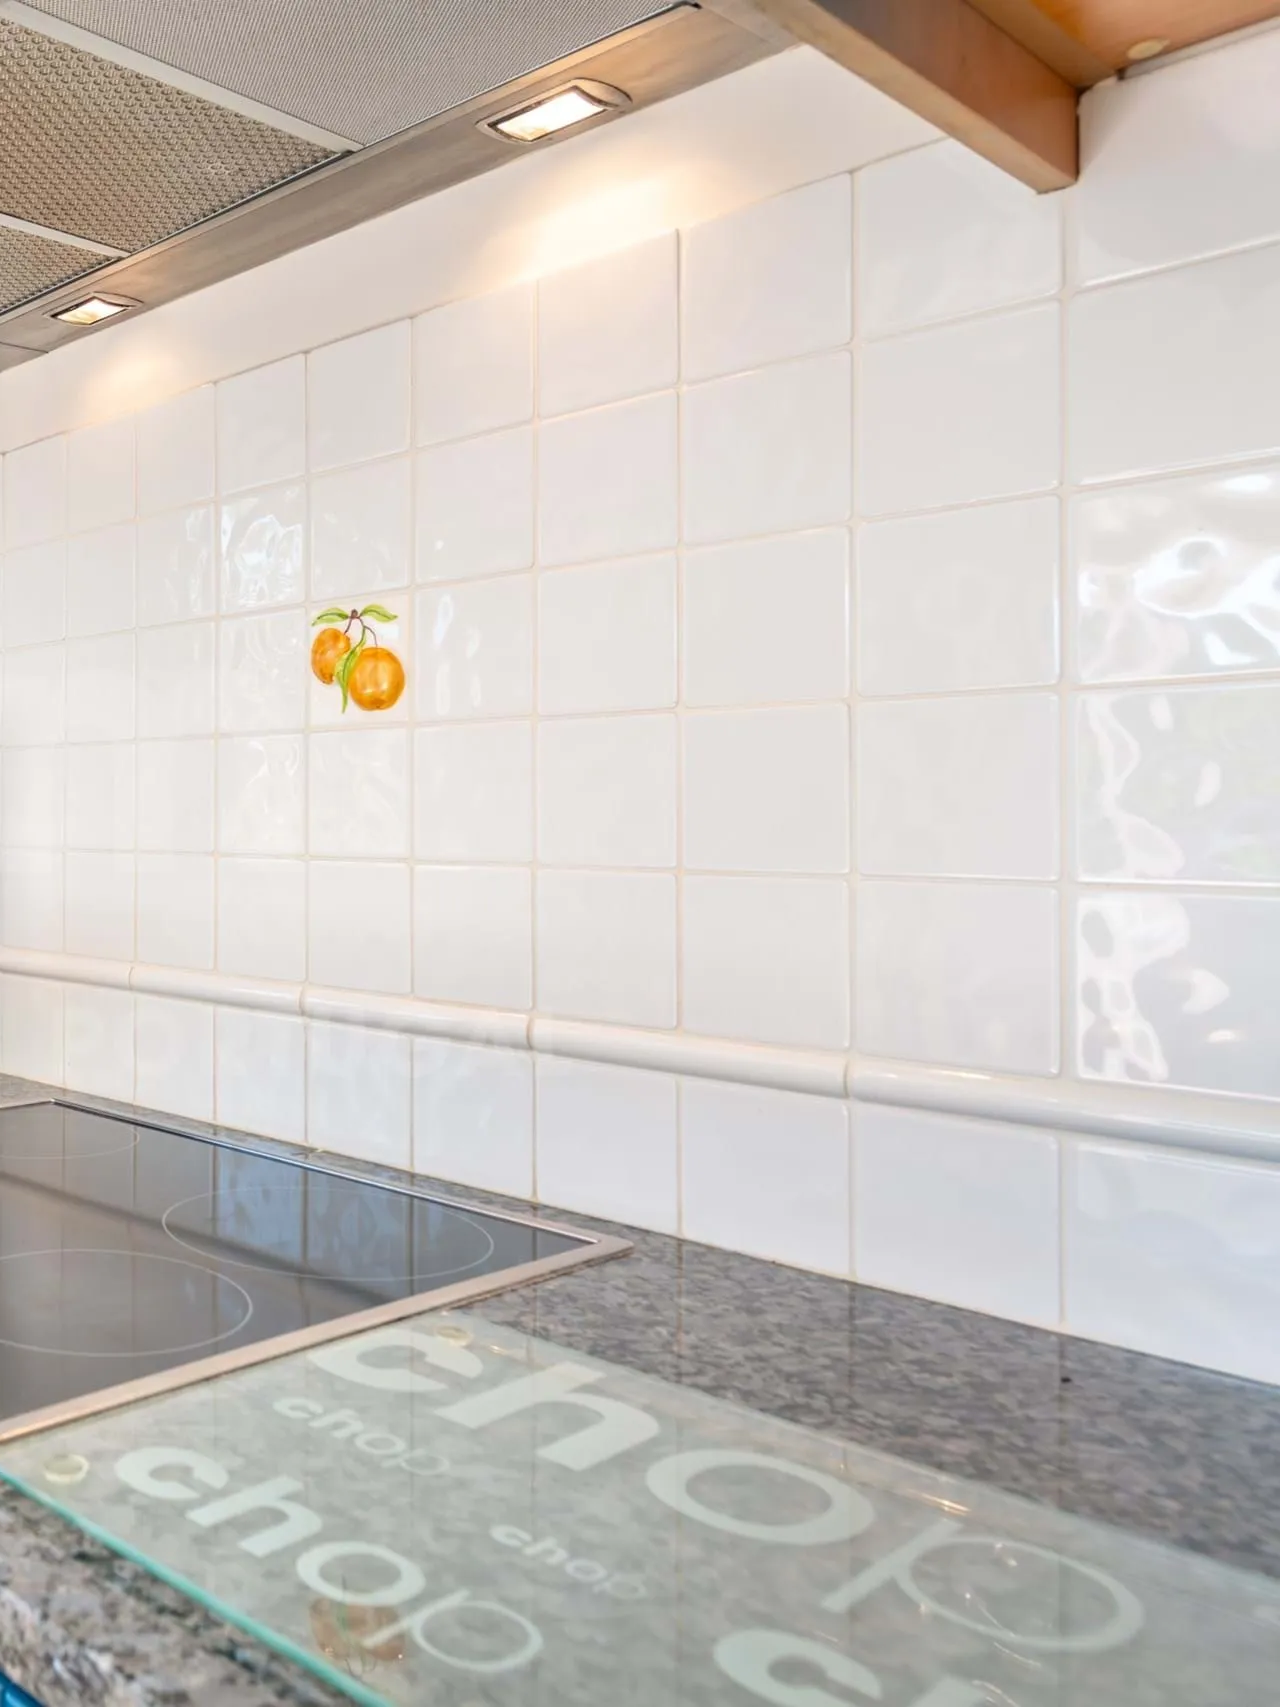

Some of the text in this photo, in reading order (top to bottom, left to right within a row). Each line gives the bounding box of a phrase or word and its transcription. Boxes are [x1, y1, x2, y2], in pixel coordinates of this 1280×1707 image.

[272, 1396, 451, 1476] chop
[307, 1327, 1145, 1654] chop
[114, 1446, 544, 1673] chop
[488, 1523, 648, 1599] chop
